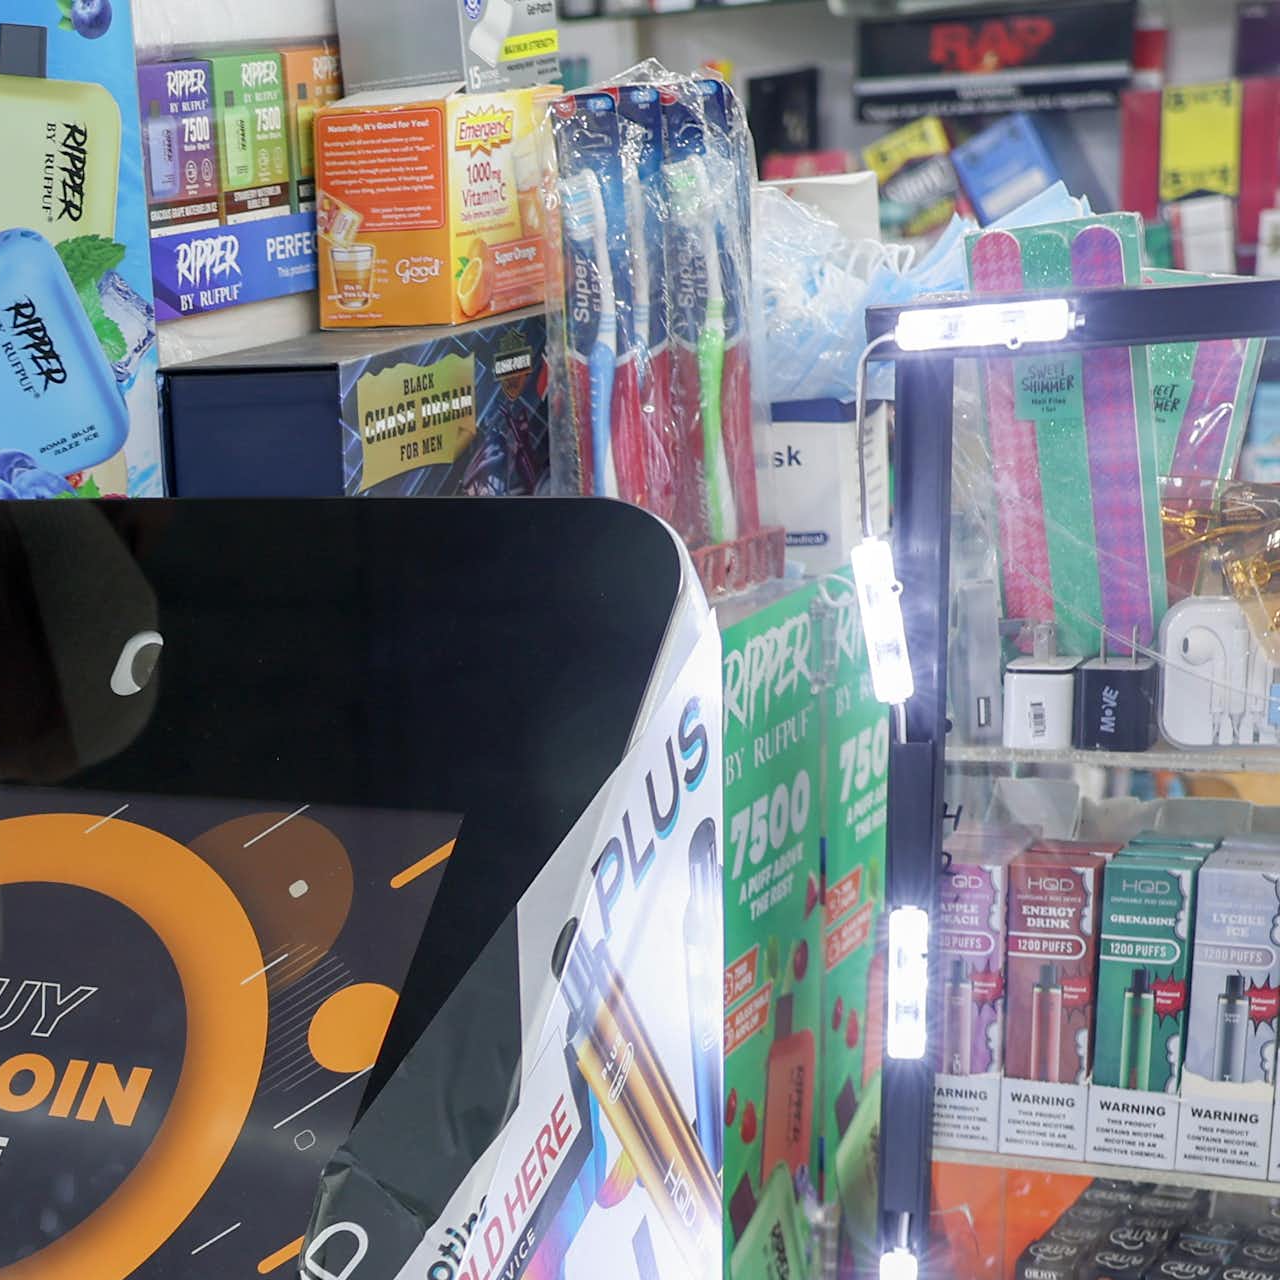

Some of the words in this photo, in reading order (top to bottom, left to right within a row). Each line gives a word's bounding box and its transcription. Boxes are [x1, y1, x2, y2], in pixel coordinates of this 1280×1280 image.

[166, 70, 207, 98] RIPPER
[241, 61, 278, 88] RIPPER
[469, 66, 480, 89] 15
[182, 116, 210, 142] 7500
[255, 107, 280, 132] 7500
[459, 116, 511, 142] Emergen-C
[46, 123, 57, 143] BY
[57, 120, 88, 222] RIPPER
[467, 162, 490, 185] 1000
[461, 186, 499, 208] Vitamin
[500, 183, 507, 201] C
[174, 235, 242, 289] RIPPER
[395, 257, 441, 284] Good
[574, 258, 589, 323] Super
[180, 293, 195, 311] BY
[2, 295, 67, 391] RIPPER
[1028, 363, 1065, 379] SWEET
[403, 373, 435, 396] BLACK
[1022, 375, 1074, 393] SHIMMER
[365, 400, 416, 444] CHASE
[421, 386, 472, 428] DREAM
[71, 424, 96, 441] BLUE
[83, 431, 100, 444] ICE
[400, 441, 419, 461] FOR
[422, 435, 443, 456] MEN
[724, 612, 812, 734] RIPPER
[725, 748, 744, 786] BY
[591, 695, 709, 940] PLUS
[729, 770, 810, 881] 7500
[1027, 877, 1074, 891] HQD
[1122, 880, 1170, 894] HQD
[739, 884, 747, 905] A
[750, 892, 771, 921] THE
[1022, 904, 1076, 917] ENERGY
[1026, 916, 1070, 929] DRINK
[1110, 914, 1176, 926] GRENADINE
[1213, 913, 1266, 926] LYCHEE
[1226, 926, 1249, 937] ICE
[1018, 939, 1040, 951] 1200
[1042, 941, 1073, 953] PUFFS
[1110, 942, 1134, 955] 1200
[1135, 944, 1167, 957] PUFFS
[1230, 949, 1263, 963] PUFFS
[933, 1087, 988, 1101] ARNING
[1010, 1092, 1076, 1108] WARNING
[1099, 1100, 1167, 1117] WARNING
[1191, 1107, 1259, 1124] WARNING
[1096, 1127, 1130, 1136] CONTAINS
[1124, 1120, 1156, 1129] PRODUCT
[1198, 1125, 1214, 1133] THIS
[1216, 1128, 1249, 1137] PRODUCT
[1187, 1134, 1222, 1143] CONTAINS
[503, 1094, 573, 1233] HERE
[664, 1157, 697, 1227] HQD
[1024, 1269, 1058, 1280] ORJOY
